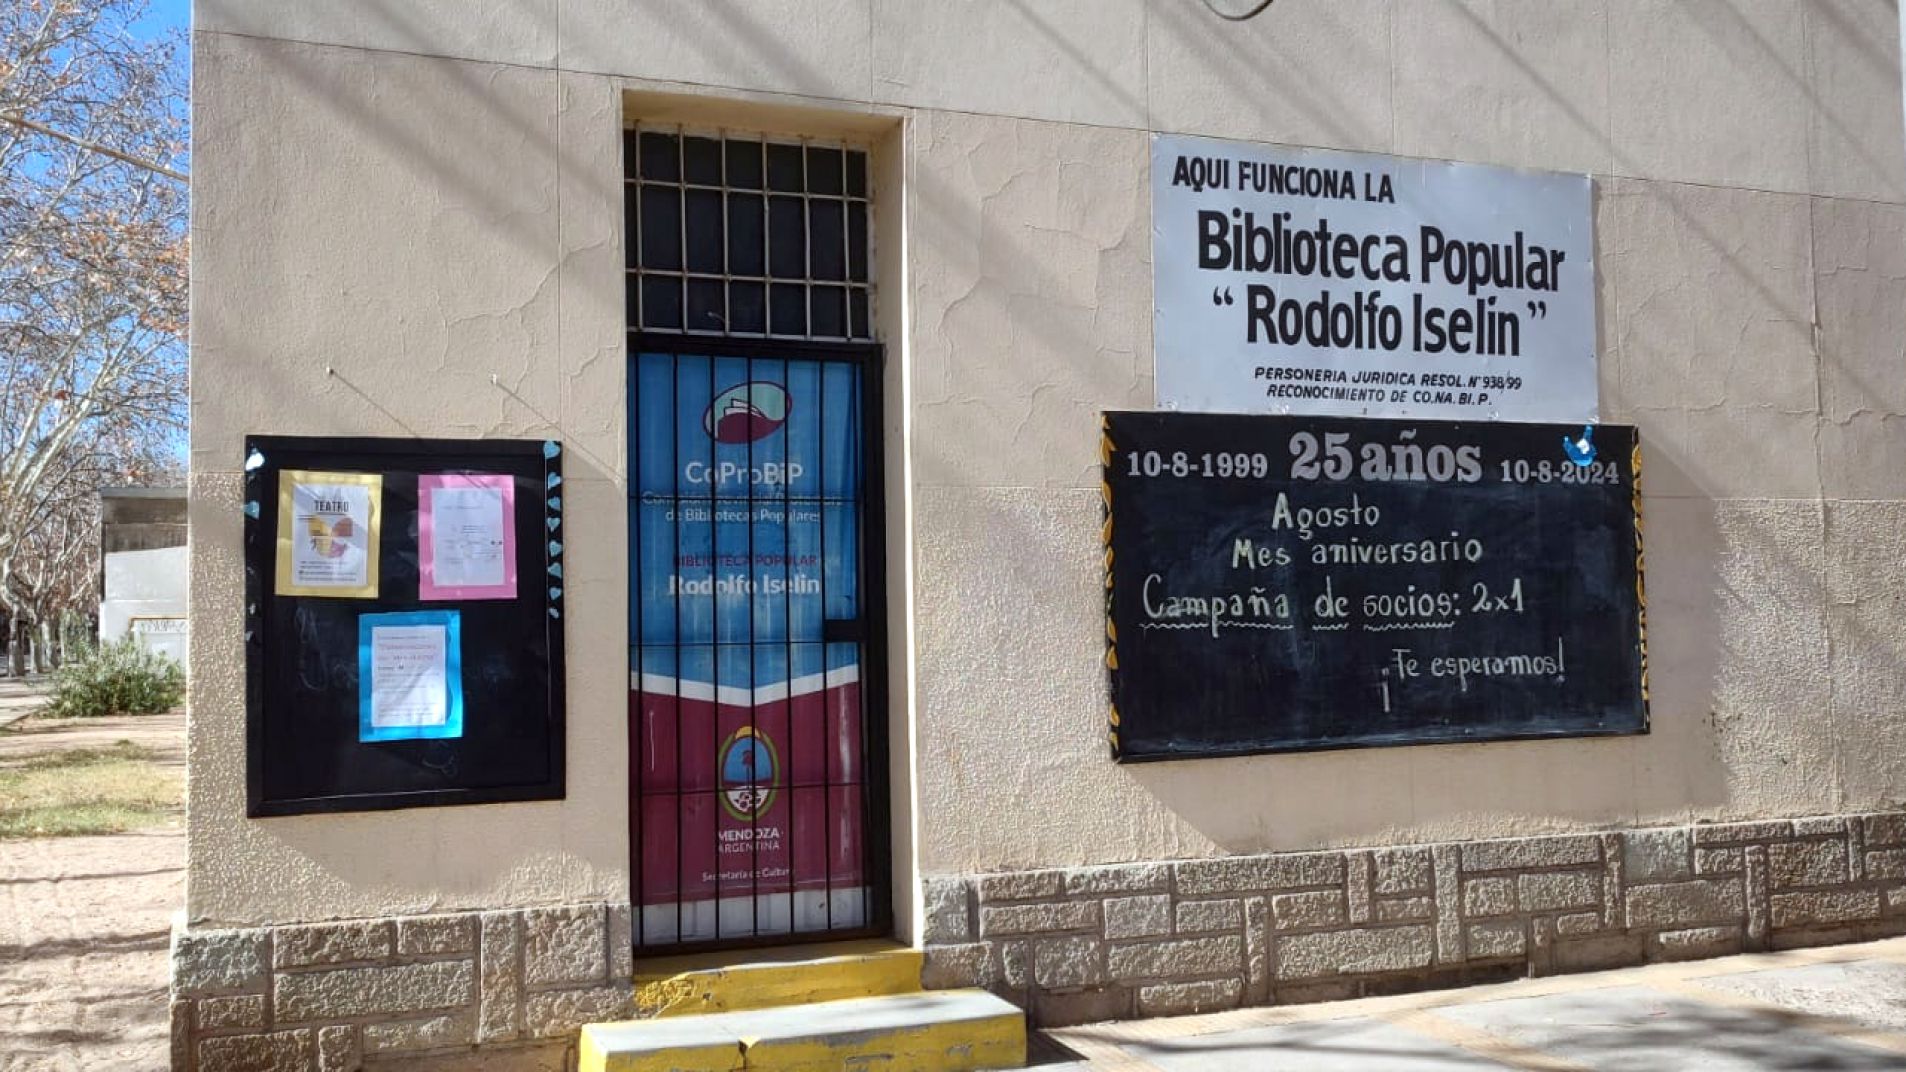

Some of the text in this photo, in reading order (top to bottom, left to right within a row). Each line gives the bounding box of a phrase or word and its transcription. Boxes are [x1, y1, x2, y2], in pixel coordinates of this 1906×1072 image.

[1172, 155, 1396, 204] AQUI FUNCIONA LA
[1197, 207, 1566, 295] Biblioteca Popular
[1254, 366, 1347, 384] PERSONERIA
[1352, 370, 1416, 386] JURIDICA
[1420, 373, 1467, 388] RESOL.
[1266, 383, 1386, 402] RECONOCIMIENTO
[1390, 389, 1408, 403] DE
[684, 461, 804, 486] CoProBiP
[1127, 428, 1620, 485] 10-8-1999 25 años 10-8-2024
[1271, 492, 1381, 540] Agosto
[1232, 531, 1484, 570] Mes aniversario
[669, 573, 820, 595] Rodolfo Iselin
[1143, 573, 1524, 638] Campaña de socios: 2x1
[1430, 636, 1566, 692] esperamos!
[718, 826, 780, 842] MENDOZA
